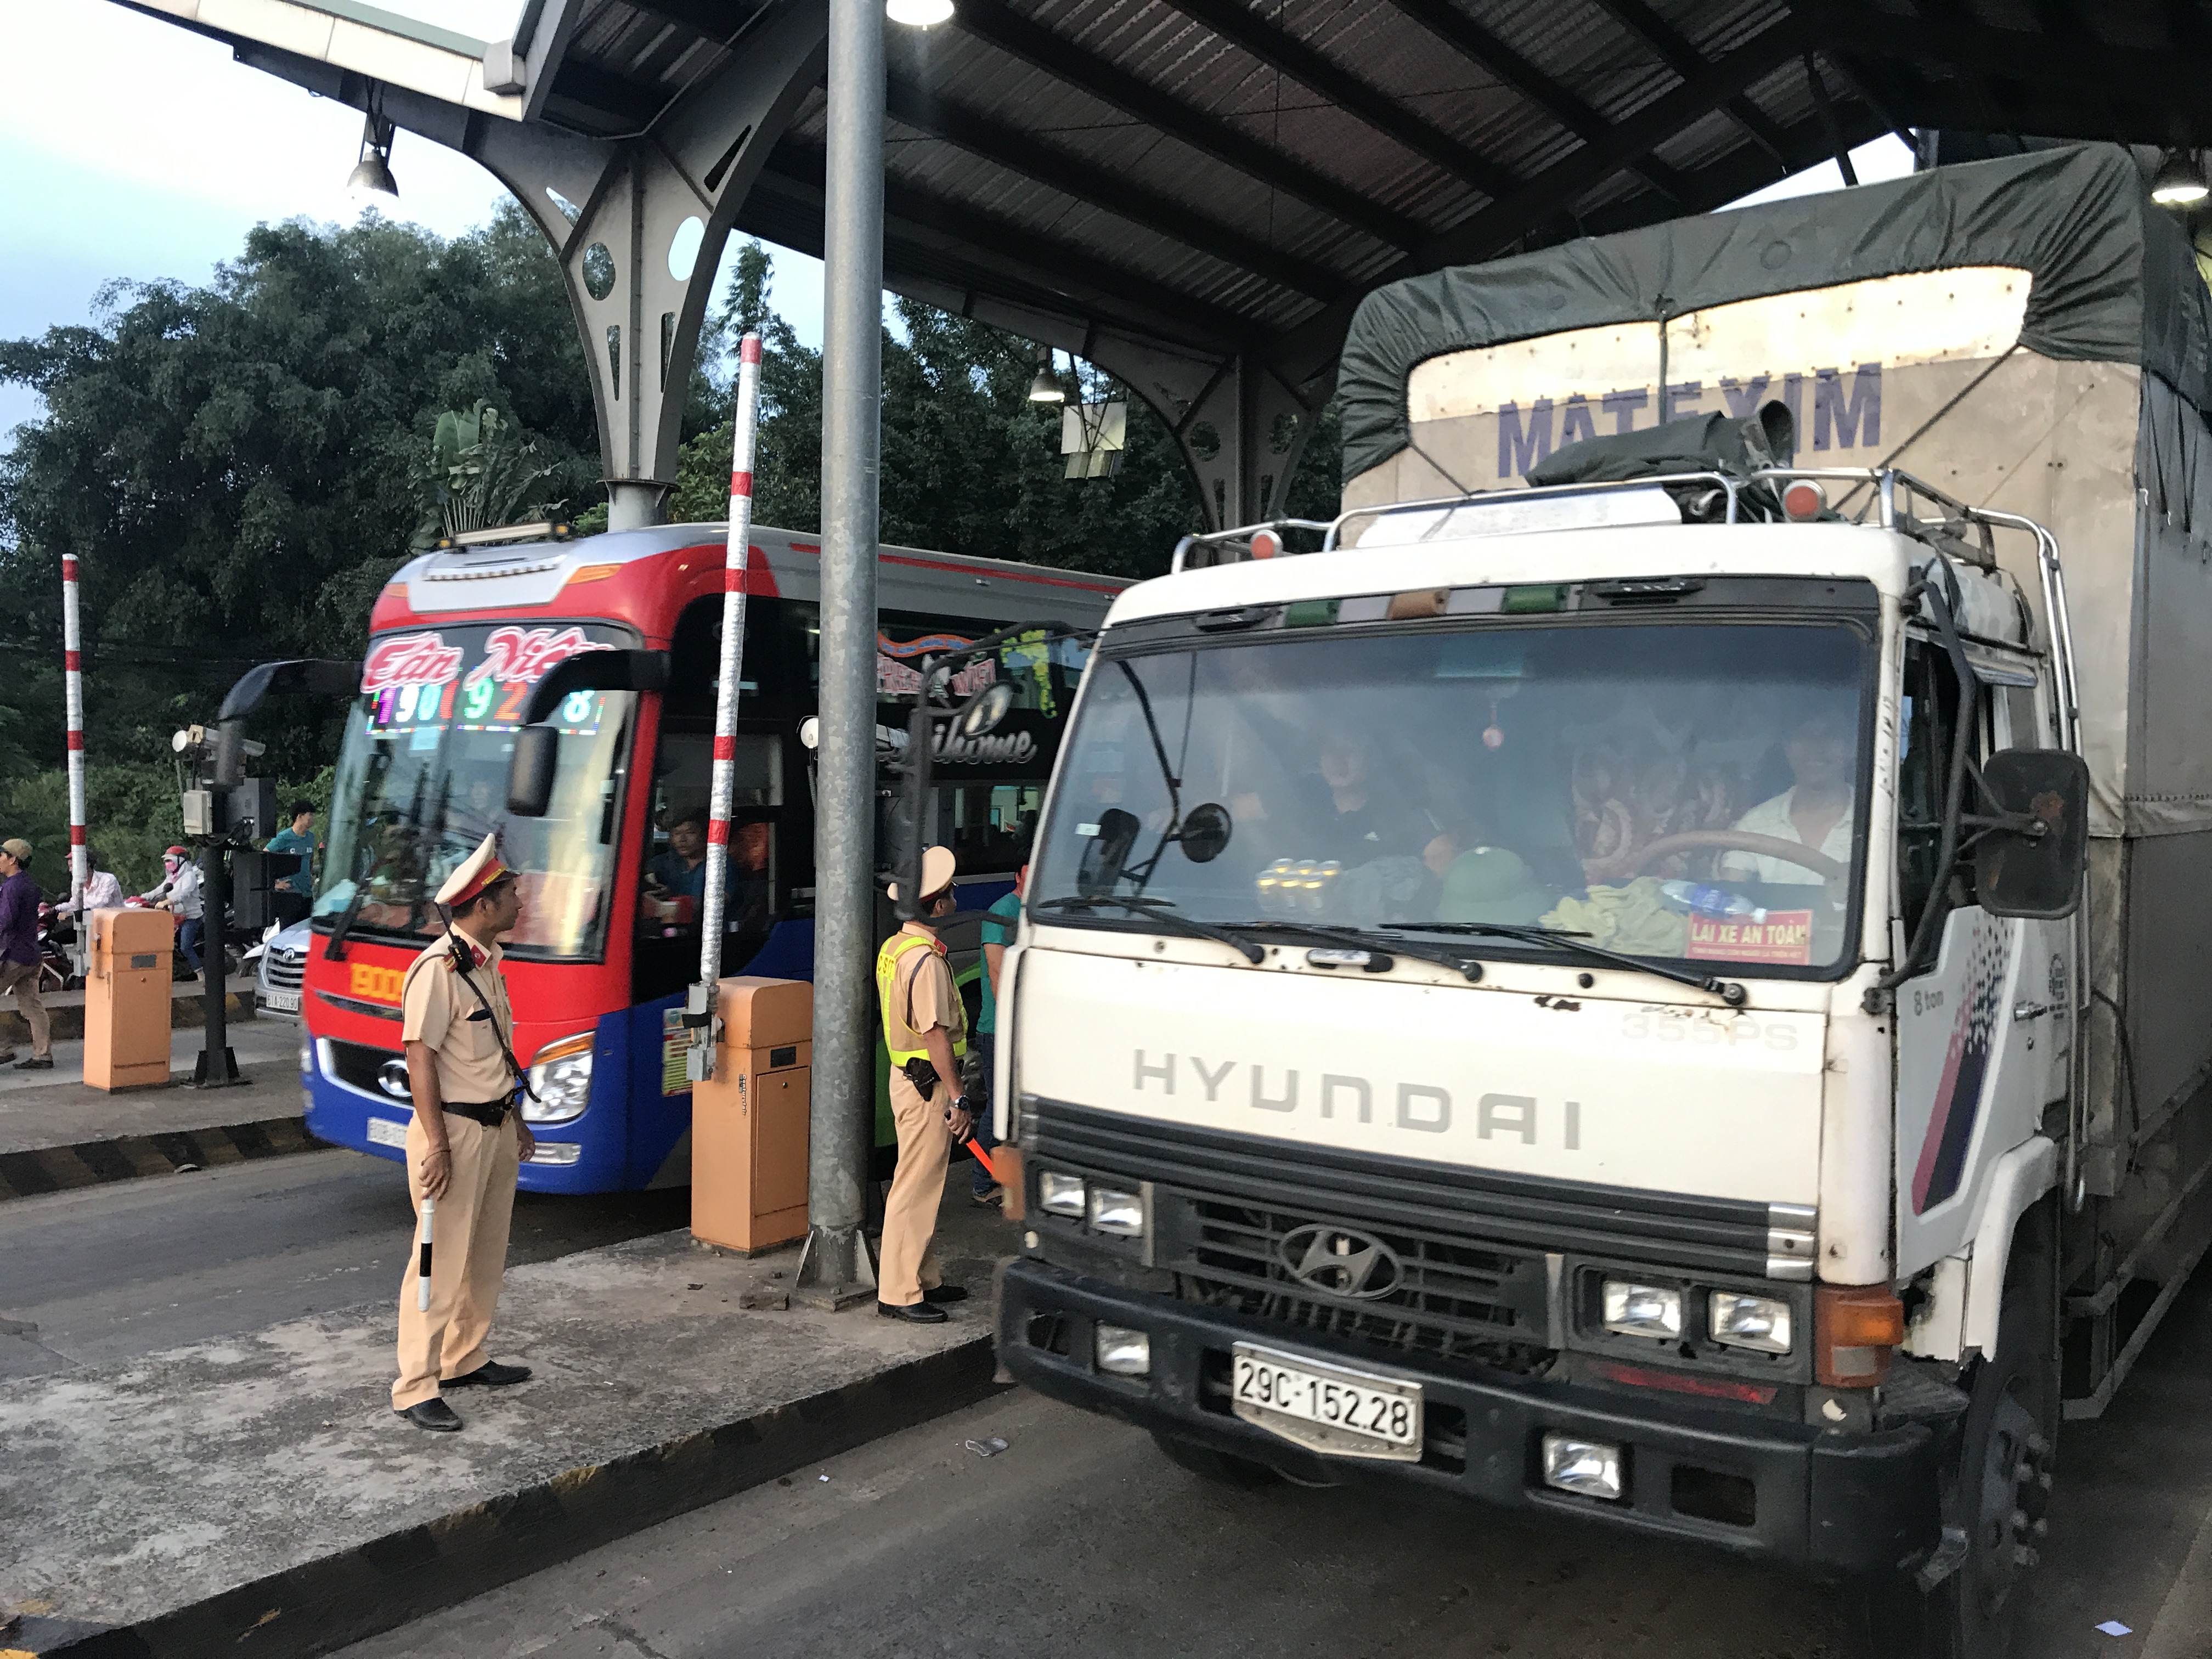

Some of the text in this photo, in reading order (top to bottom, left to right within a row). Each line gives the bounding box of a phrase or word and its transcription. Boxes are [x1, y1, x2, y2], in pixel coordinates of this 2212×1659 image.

[1718, 924, 1738, 943] XE
[1740, 925, 1763, 944] AN
[1914, 990, 1922, 1016] 8
[1621, 1013, 1798, 1051] 355PS
[1133, 1048, 1582, 1150] HYUNDAI
